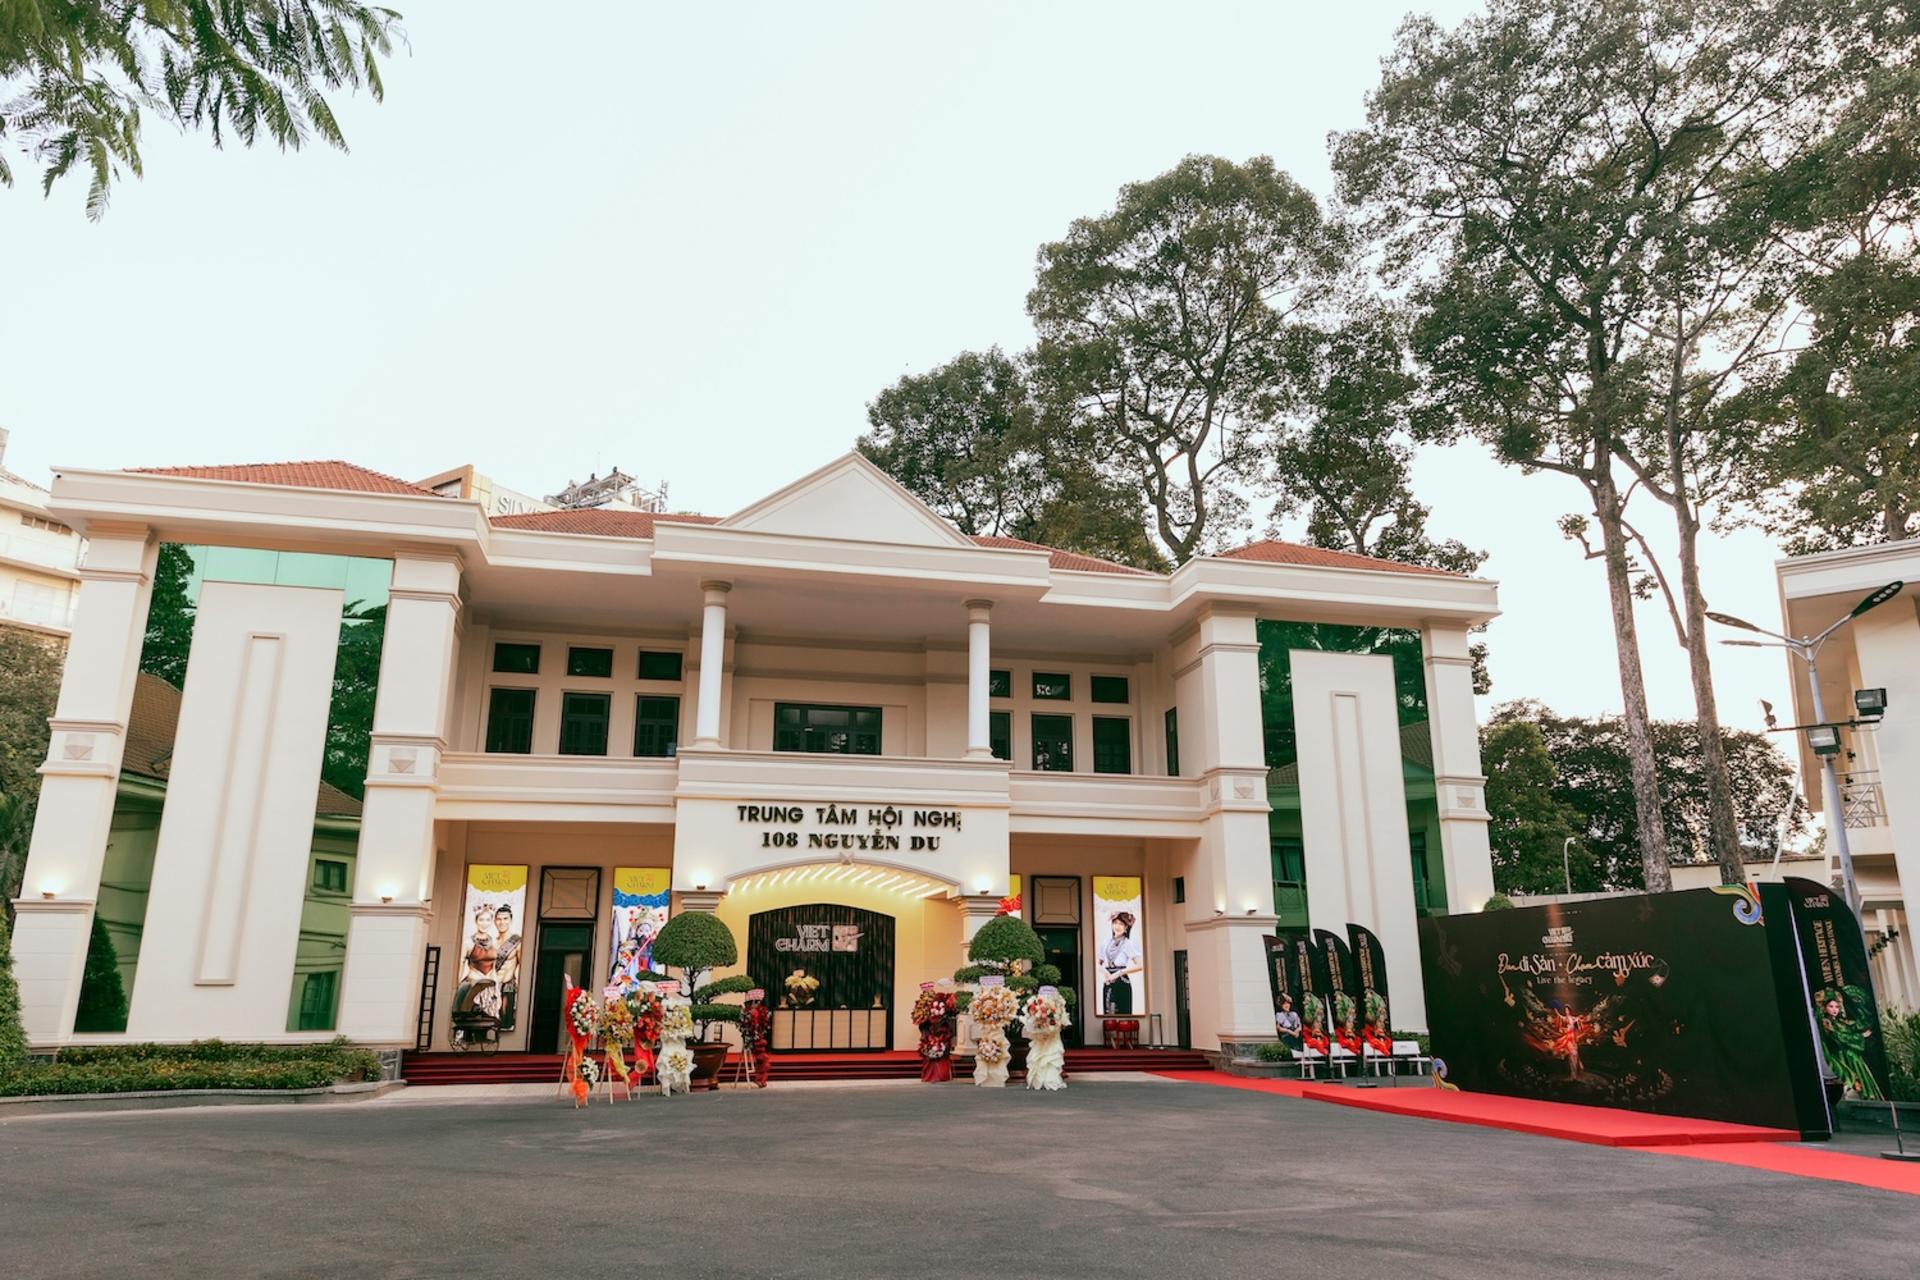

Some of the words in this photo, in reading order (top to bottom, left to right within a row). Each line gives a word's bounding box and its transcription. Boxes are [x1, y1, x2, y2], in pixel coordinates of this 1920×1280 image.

[737, 805, 804, 824] TRUNG
[816, 803, 857, 825] TÂM
[868, 805, 903, 830] HỘI
[914, 810, 961, 832] NGHỊ
[762, 831, 799, 848] 108
[808, 827, 900, 850] NGUYỄN
[910, 835, 941, 851] DU
[796, 924, 830, 939] VIET
[775, 937, 830, 952] CHARM
